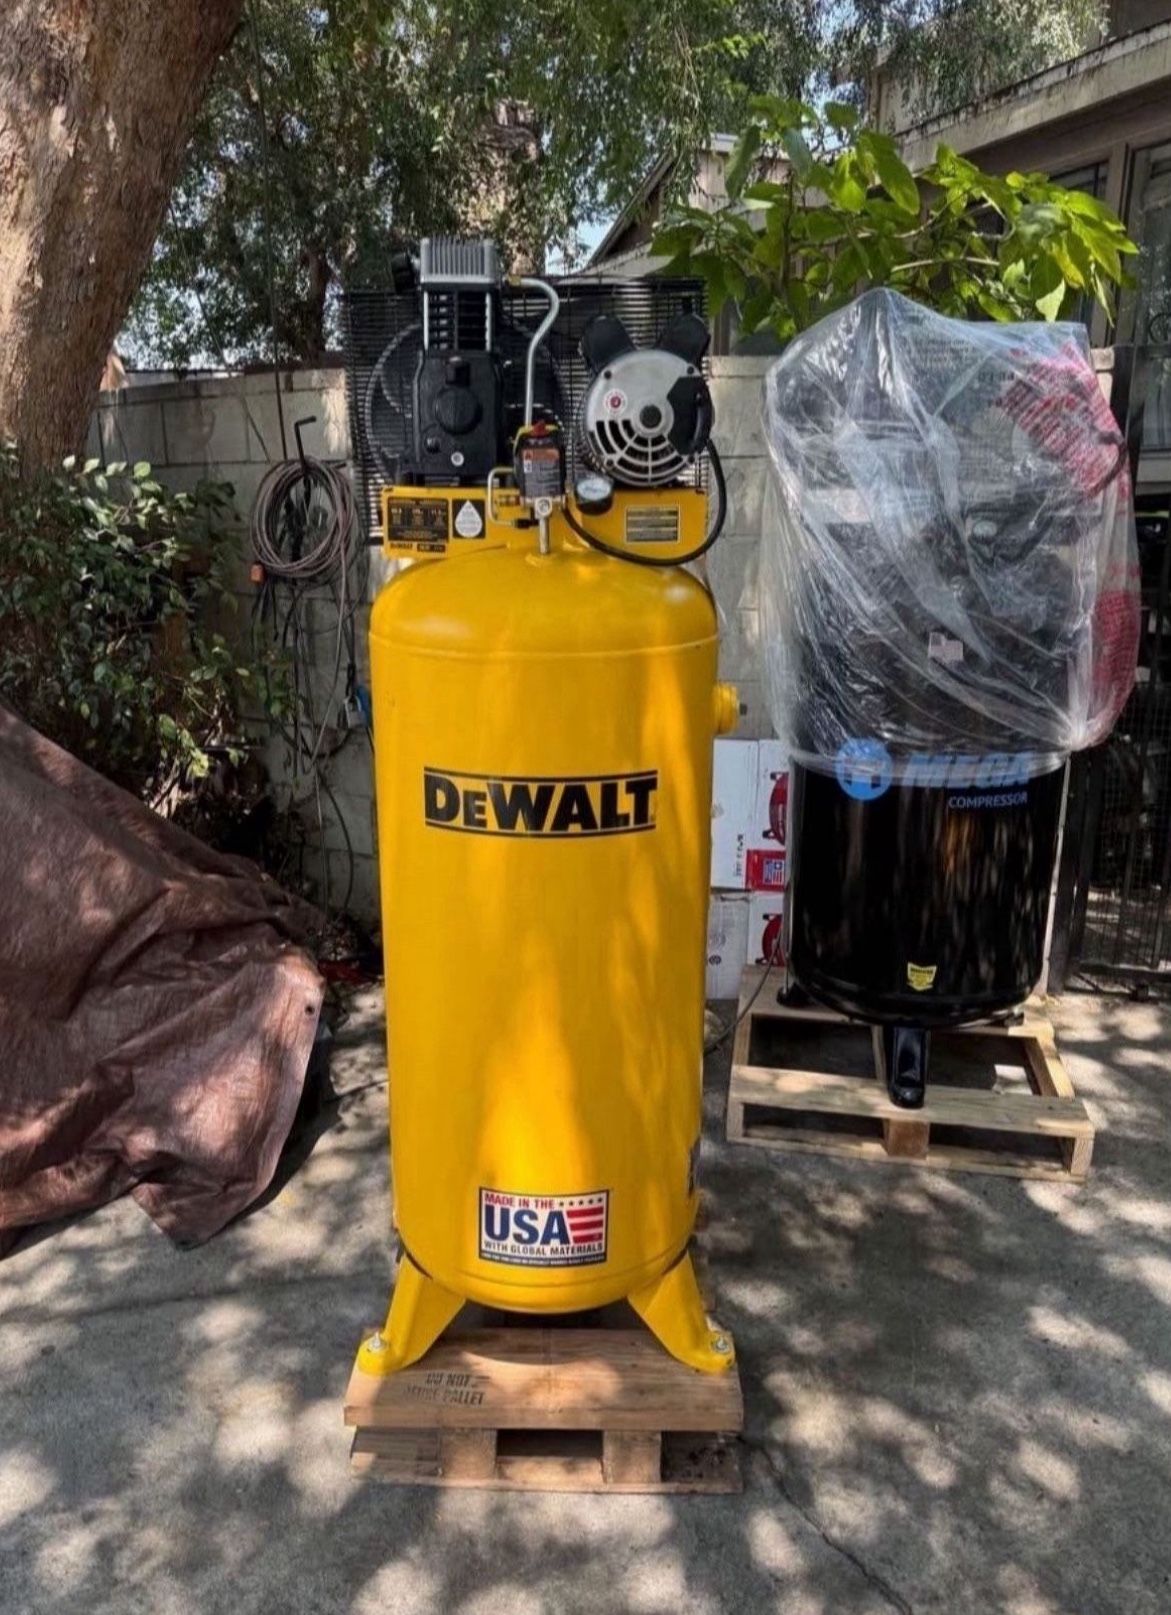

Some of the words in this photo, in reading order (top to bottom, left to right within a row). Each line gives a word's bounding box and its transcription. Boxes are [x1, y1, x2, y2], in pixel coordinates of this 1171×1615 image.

[424, 773, 658, 832] DEWALT
[949, 791, 1028, 809] COMPRESSOR
[485, 1193, 514, 1206] MADE
[519, 1198, 529, 1208] IN
[535, 1199, 555, 1209] THE
[485, 1204, 570, 1245] USA
[484, 1240, 508, 1253] WITH
[511, 1244, 546, 1256] GLOBAL
[550, 1242, 603, 1256] MATERIALS
[446, 1373, 473, 1388] NOT
